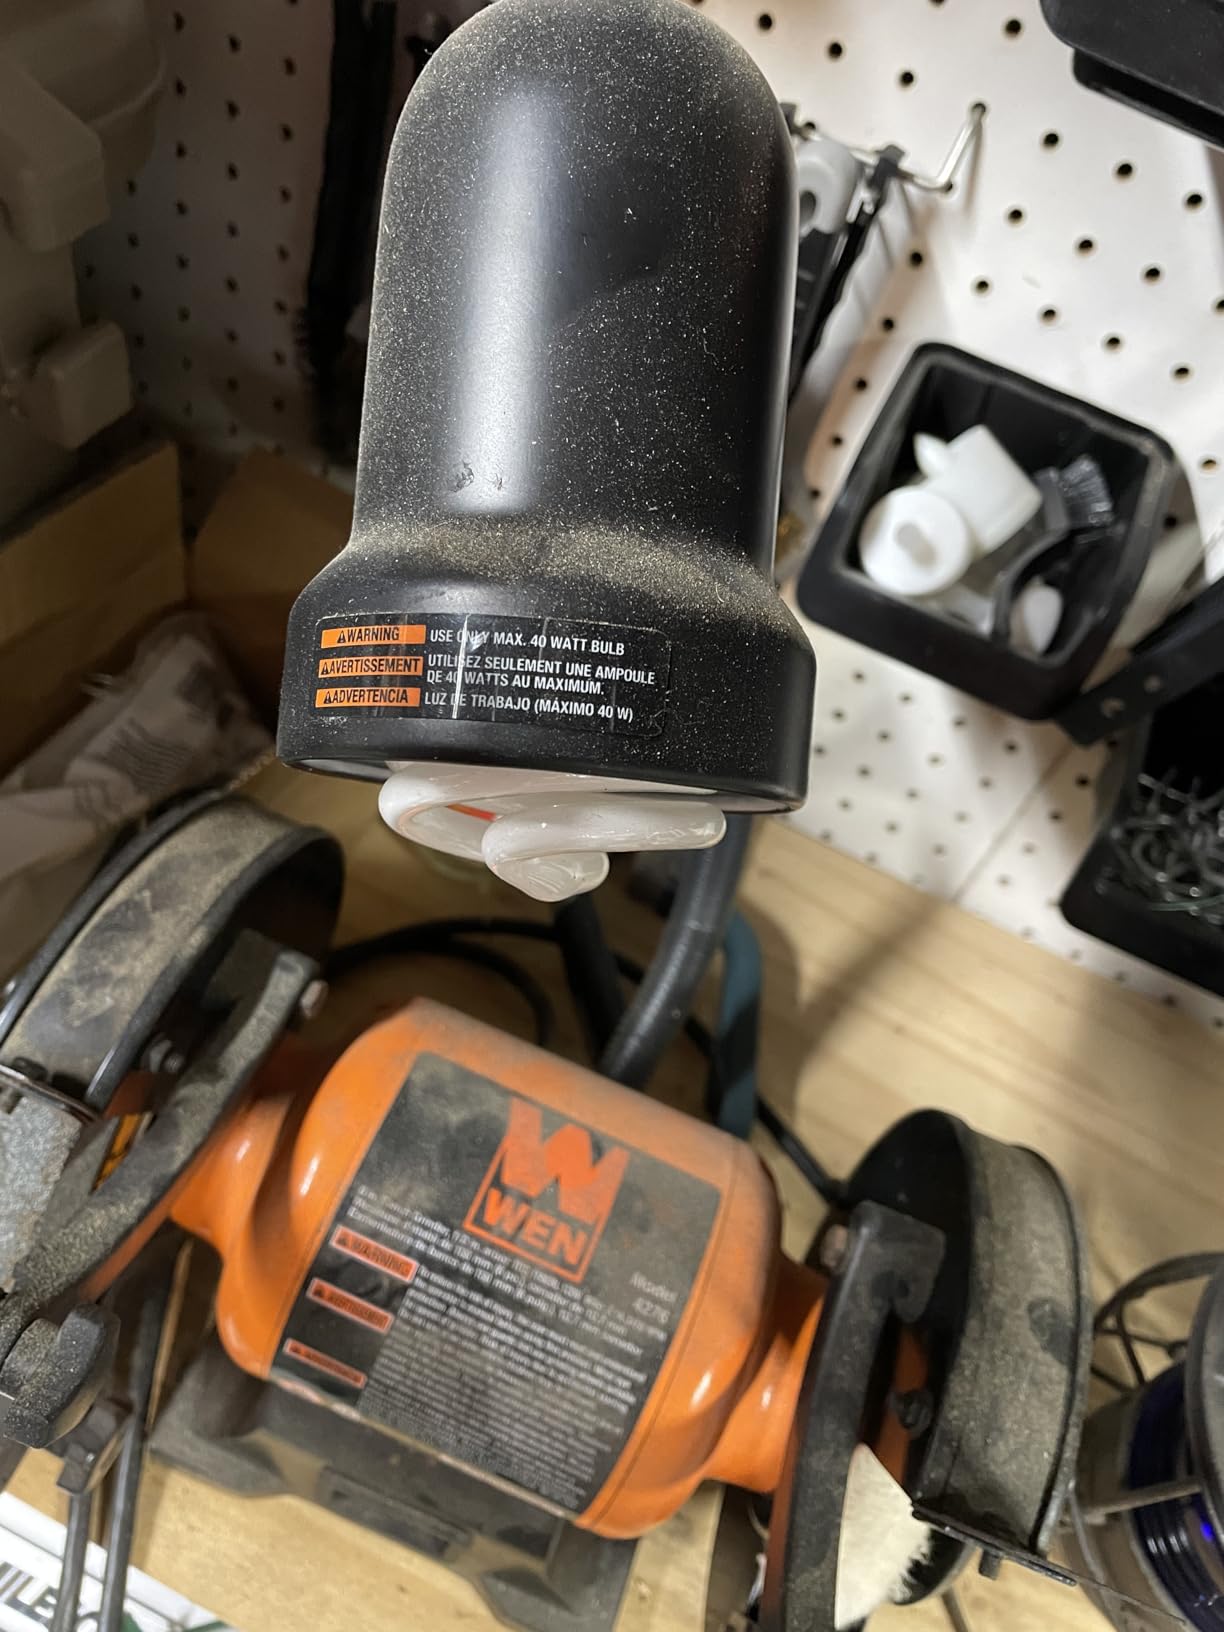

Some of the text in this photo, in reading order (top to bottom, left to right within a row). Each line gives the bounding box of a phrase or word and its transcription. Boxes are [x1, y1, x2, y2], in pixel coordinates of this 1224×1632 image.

[347, 627, 399, 643] WARNING
[430, 629, 625, 656] USE ONLY MAX. 40 WATT BULB
[329, 658, 420, 674] AVERTISSEMENT
[428, 654, 655, 685] UTILISEZ SEULEMENT UNE AMPOULE
[427, 670, 442, 683] DE
[464, 671, 509, 686] WATTS
[512, 675, 531, 688] AU
[534, 676, 604, 695] MAXIMUM.
[332, 688, 408, 704] ADVERTENCIA
[424, 691, 448, 705] LUZ
[450, 692, 467, 706] DE
[471, 694, 531, 711] TRABAJO
[597, 704, 614, 718] 40
[617, 706, 633, 723] W)
[484, 1187, 590, 1264] WEN
